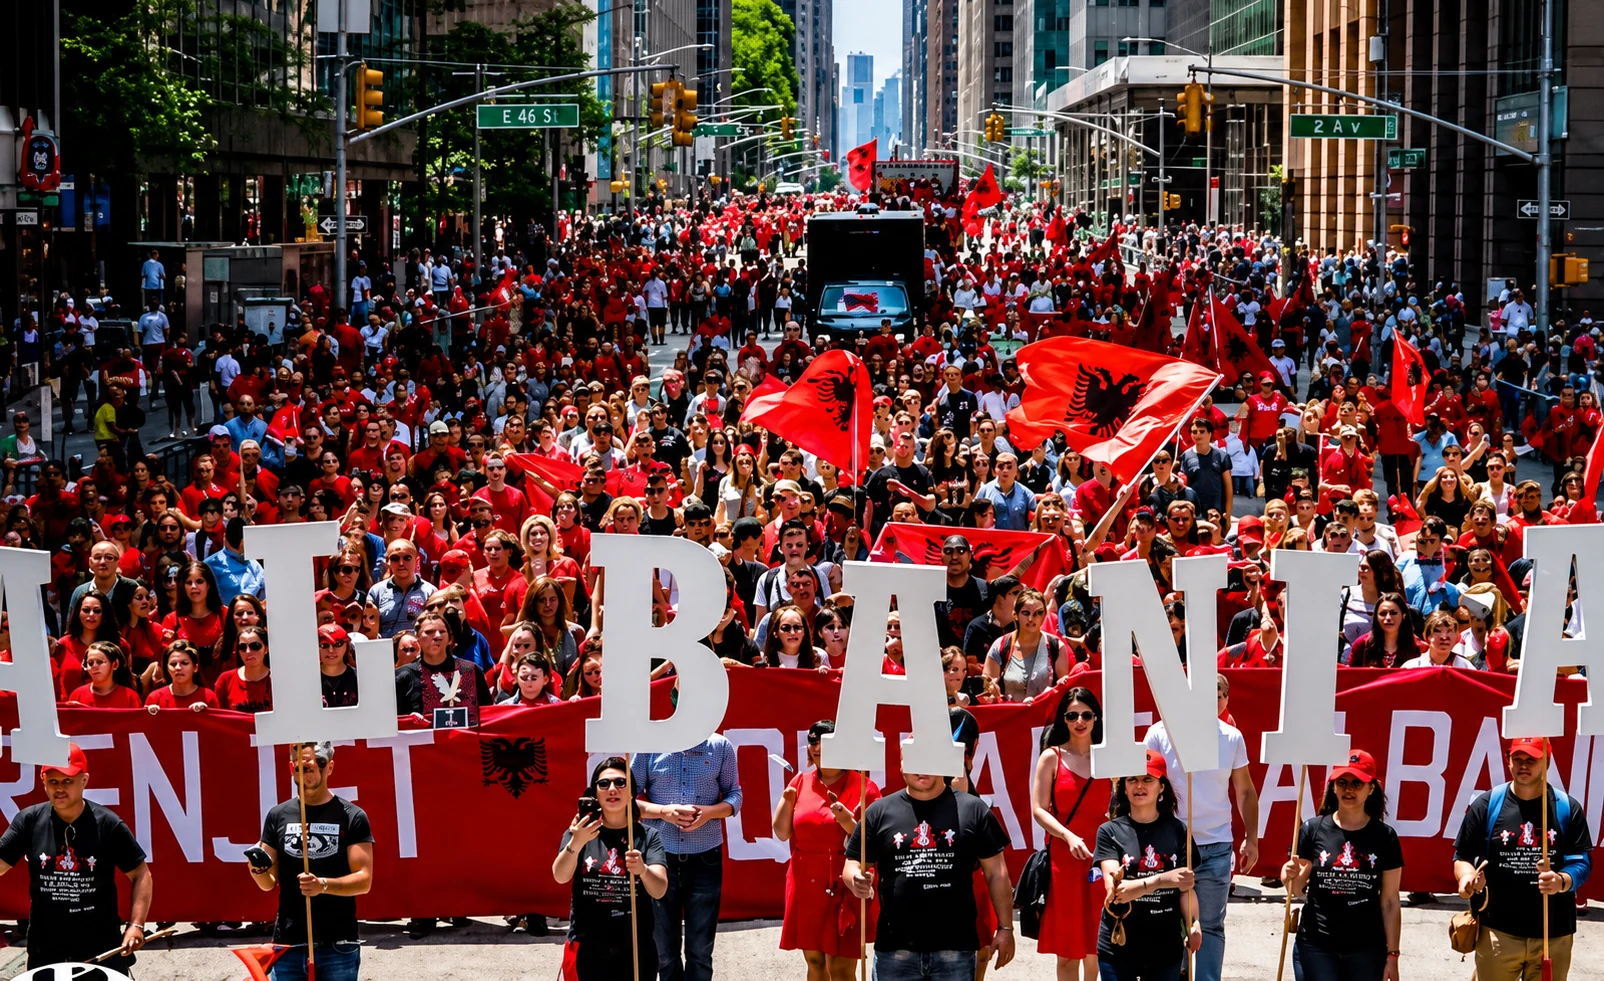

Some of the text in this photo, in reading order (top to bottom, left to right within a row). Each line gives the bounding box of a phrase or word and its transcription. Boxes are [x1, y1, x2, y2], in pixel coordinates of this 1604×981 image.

[503, 108, 559, 124] E 46 St
[1314, 119, 1324, 134] 2
